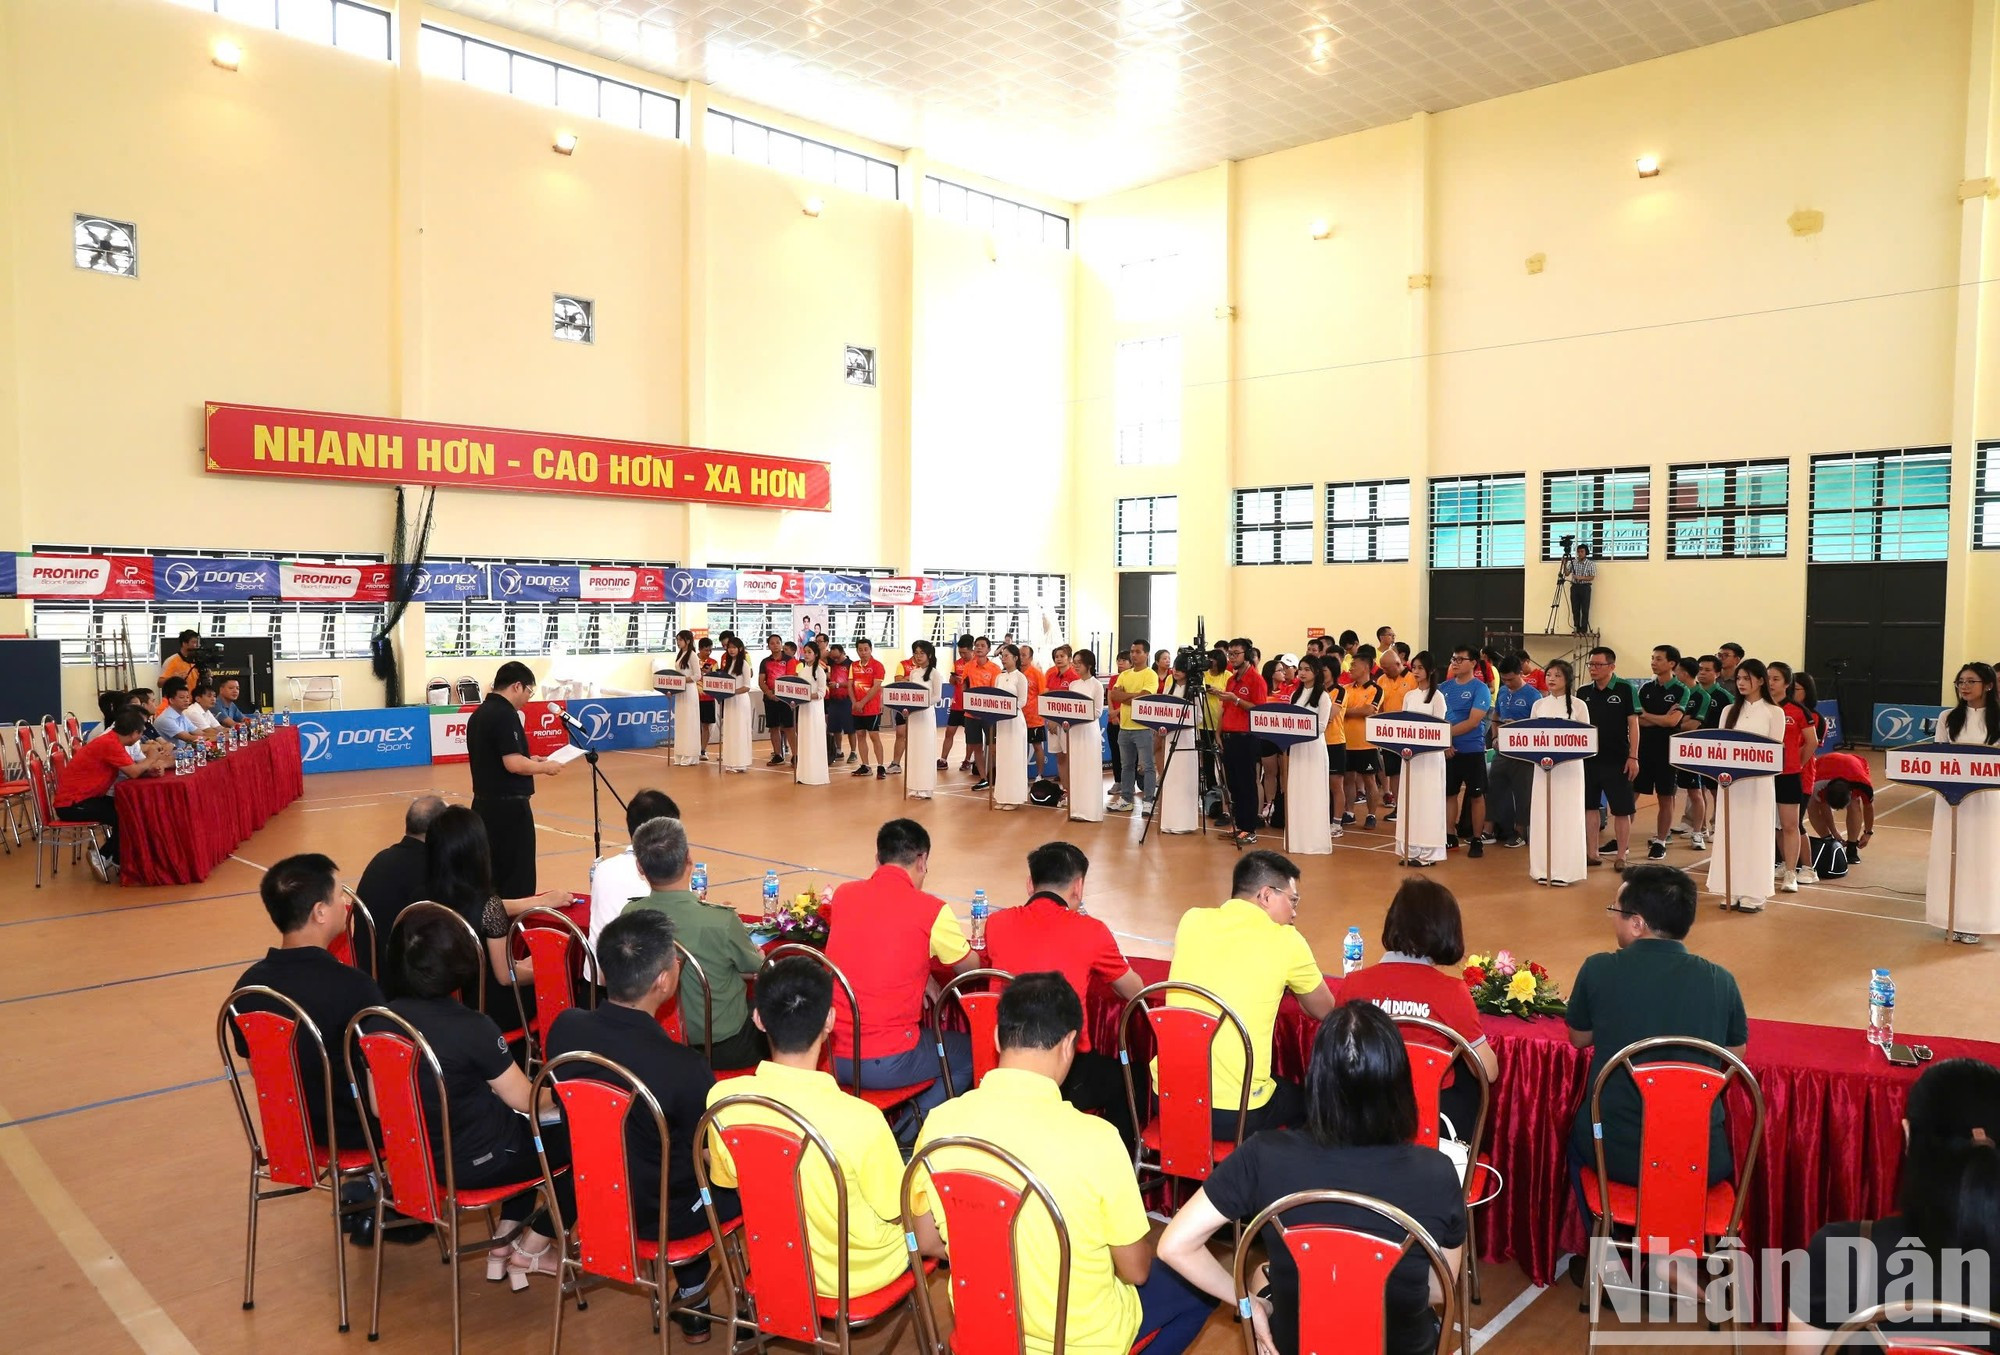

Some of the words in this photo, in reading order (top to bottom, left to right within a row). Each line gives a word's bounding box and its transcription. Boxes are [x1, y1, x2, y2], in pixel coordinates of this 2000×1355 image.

[254, 424, 403, 469] NHANH
[417, 437, 495, 476] HƠN
[532, 447, 599, 483] CAO
[609, 454, 673, 489] HƠN
[704, 463, 742, 494] XA
[750, 467, 806, 499] HƠN
[33, 568, 99, 579] PRONING
[203, 571, 266, 582] DONEX
[293, 574, 352, 585] PRONING
[434, 574, 478, 585] DONEX
[525, 576, 570, 586] DONEX
[589, 577, 630, 587] PRONING
[696, 578, 730, 589] DONEX
[828, 583, 863, 592] DONEX
[889, 691, 900, 701] BÁO
[912, 692, 925, 702] BÌNH
[970, 696, 982, 707] BÁO
[1000, 699, 1012, 710] YÊN
[1046, 701, 1072, 714] TRỌNG
[1075, 701, 1087, 714] TÀI
[1138, 703, 1152, 715] BÁO
[1154, 705, 1173, 718] NHÂN
[1254, 712, 1268, 727] BÁO
[1270, 713, 1280, 728] HÀ
[1282, 715, 1295, 731] NỘI
[1297, 715, 1312, 730] MỚI
[337, 726, 415, 745] DONEX
[533, 729, 562, 738] PRONING
[1376, 723, 1393, 738] BÁO
[1396, 724, 1416, 739] THÁI
[1418, 724, 1441, 740] BÌNH
[1509, 730, 1528, 747] BÁO
[1533, 730, 1549, 748] HẢI
[1554, 734, 1588, 748] DƯƠNG
[376, 742, 412, 753] Sport
[1679, 740, 1702, 758] BÁO
[1707, 741, 1727, 760] HẢI
[1733, 745, 1774, 763] PHÒNG
[1901, 757, 1931, 775] BÁO
[1940, 758, 1961, 775] HÀ
